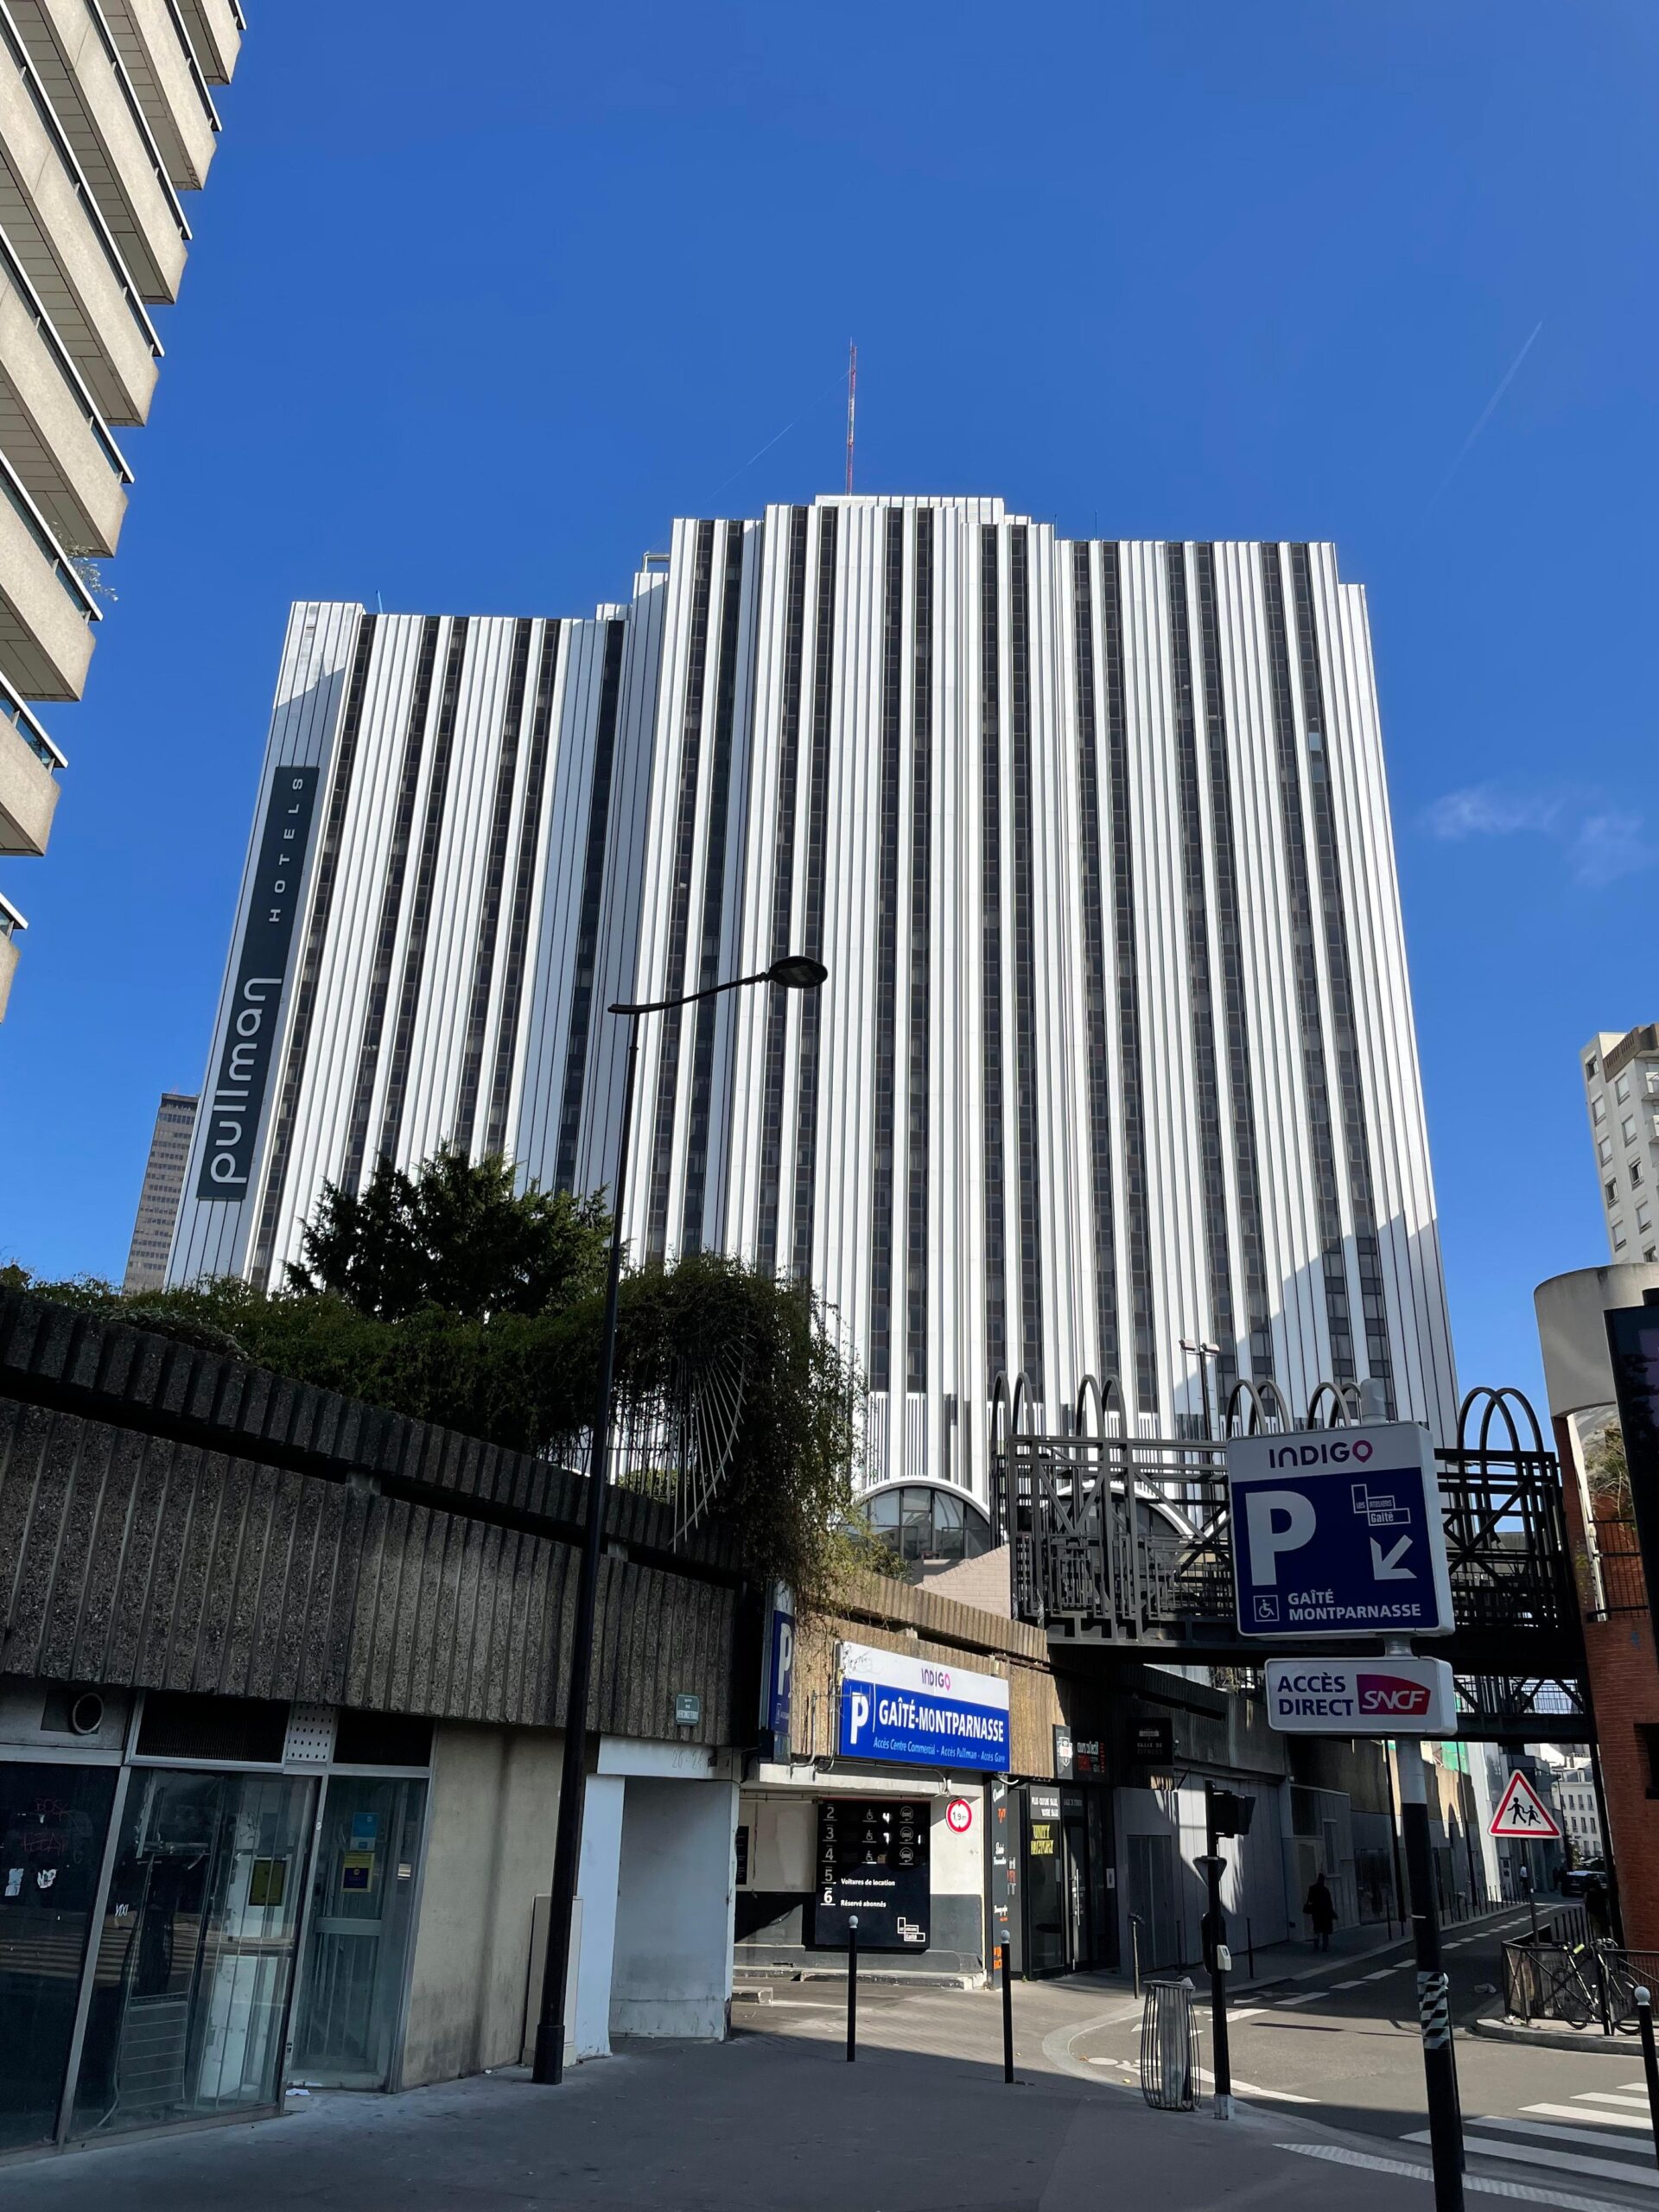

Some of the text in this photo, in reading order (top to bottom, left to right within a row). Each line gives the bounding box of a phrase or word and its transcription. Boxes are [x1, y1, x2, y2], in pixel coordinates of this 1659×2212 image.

[209, 778, 303, 1185] pullman HOTELS
[1268, 1440, 1373, 1469] INDIGO
[1245, 1491, 1317, 1586] P
[1287, 1589, 1335, 1605] GAÎTÉ
[1288, 1604, 1421, 1621] MONTPARNASSE
[921, 1668, 951, 1691] INDIGO
[1277, 1672, 1346, 1694] ACCÈS
[1279, 1699, 1354, 1717] DIRECT
[1362, 1690, 1426, 1710] SNCF
[850, 1691, 869, 1745] P
[879, 1696, 1004, 1743] GAÎTÉ-MONTPARNASSE
[874, 1737, 889, 1749] Accès
[890, 1738, 907, 1752] Centre
[908, 1741, 935, 1755] Commercial
[941, 1745, 956, 1758] Accès
[957, 1747, 977, 1759] Pullman
